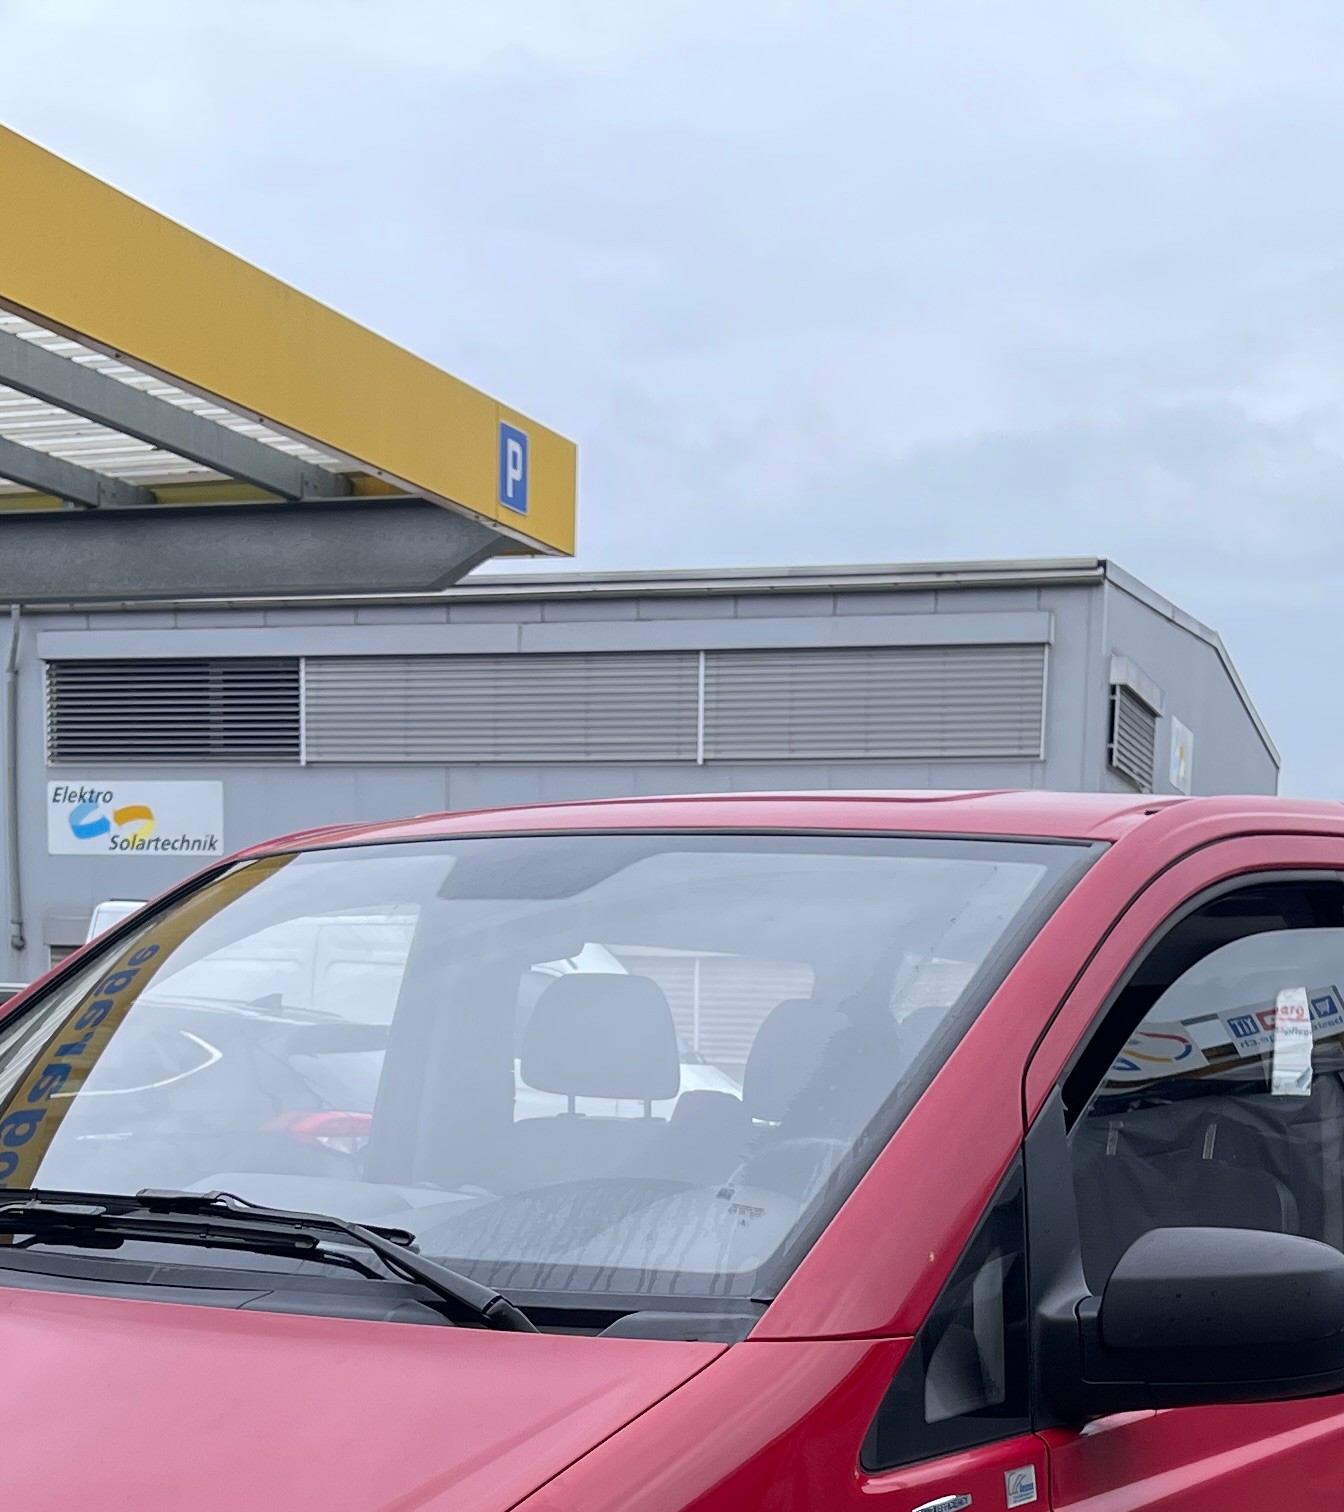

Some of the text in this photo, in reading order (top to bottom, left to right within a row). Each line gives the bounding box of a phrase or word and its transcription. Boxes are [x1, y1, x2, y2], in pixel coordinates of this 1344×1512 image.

[506, 438, 523, 498] P
[52, 786, 114, 804] Elektro
[108, 834, 219, 851] Solartechnik
